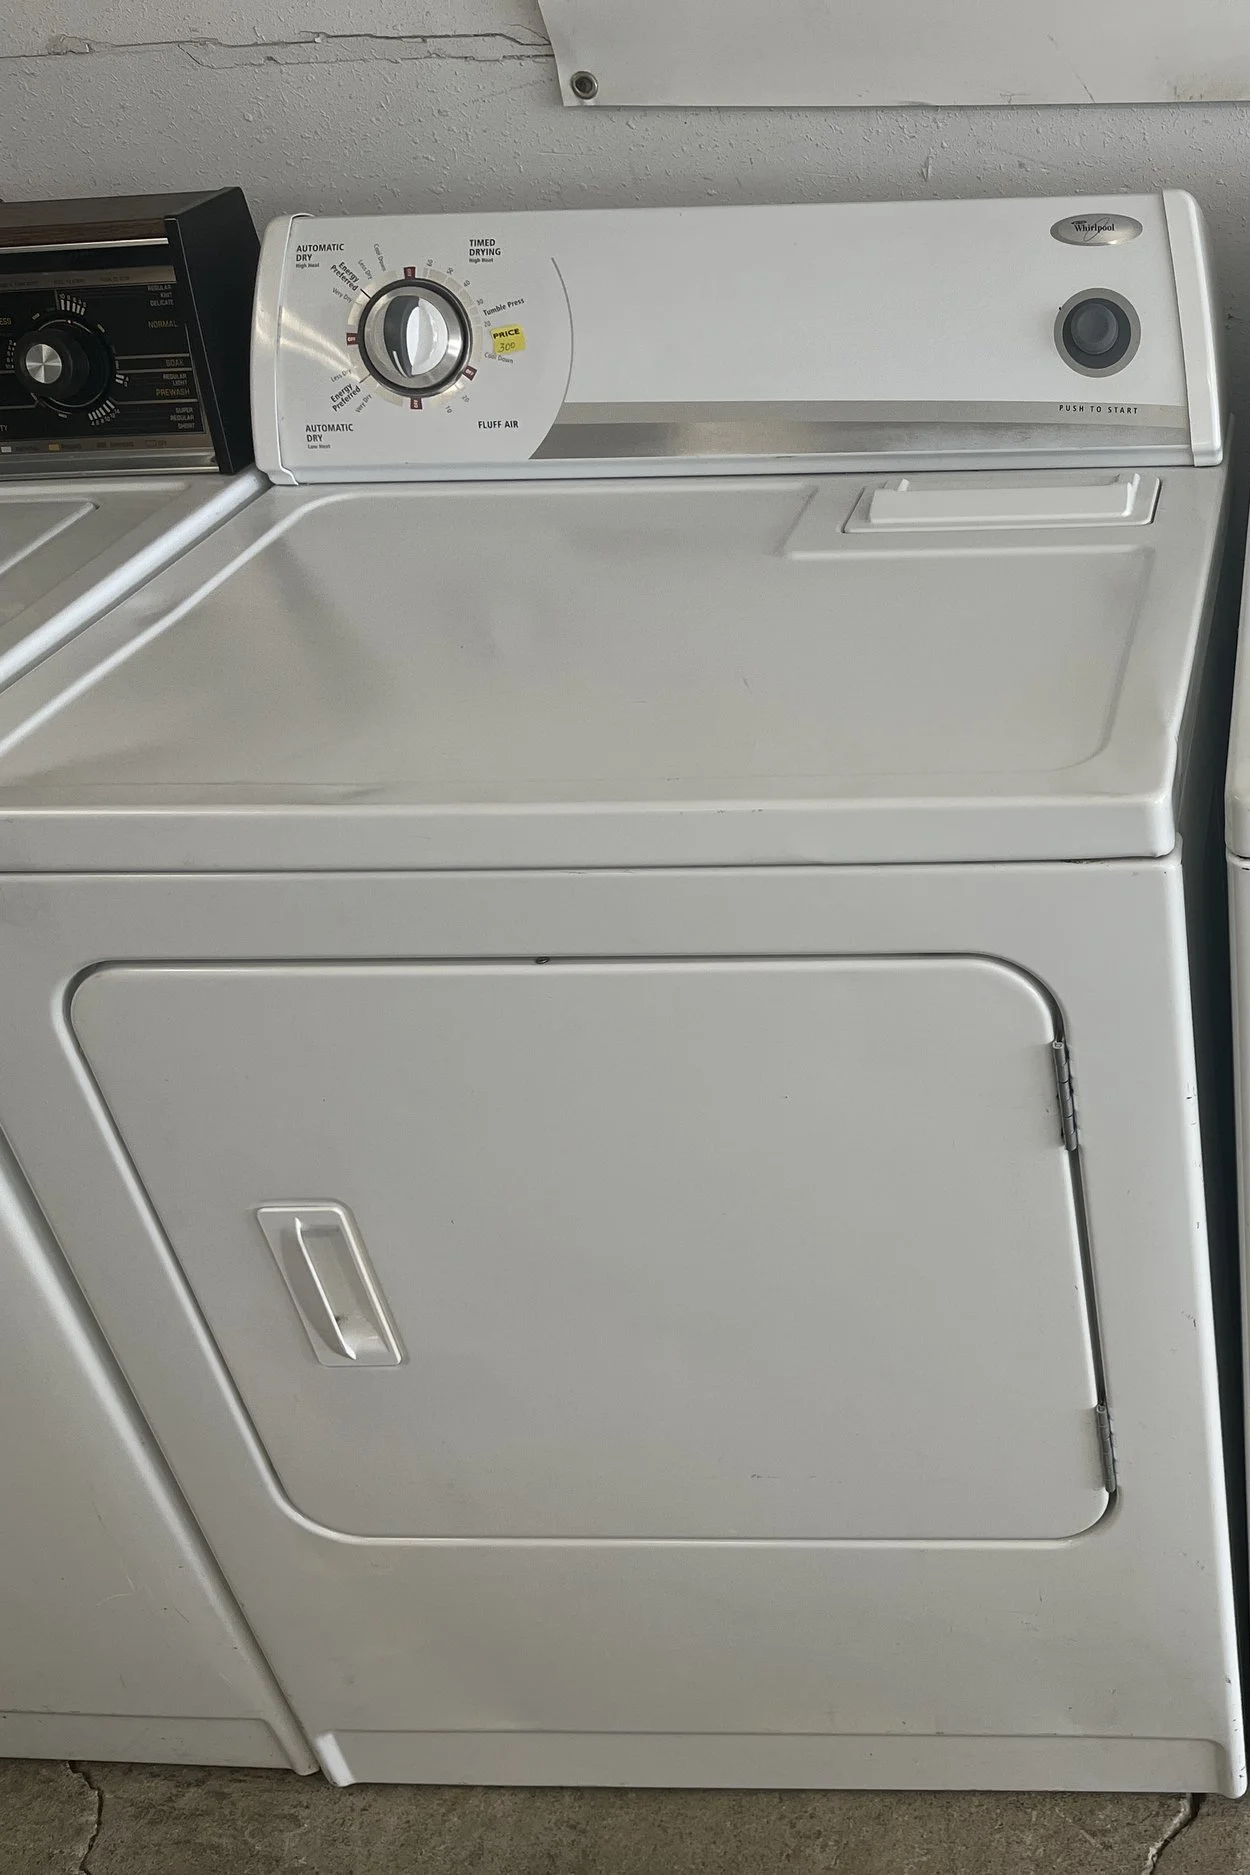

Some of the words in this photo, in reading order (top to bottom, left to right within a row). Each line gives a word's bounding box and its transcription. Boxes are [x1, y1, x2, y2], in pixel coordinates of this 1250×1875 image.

[1074, 223, 1115, 233] Whirlpool
[296, 243, 344, 252] AUTOMATIC
[469, 239, 496, 247] TIMED
[469, 248, 501, 256] DRYING
[296, 254, 313, 262] DRY
[338, 261, 360, 283] Energy
[330, 264, 359, 291] Preferred
[483, 304, 506, 316] Tumble
[507, 298, 525, 308] Press
[493, 328, 520, 339] PRICE
[330, 383, 353, 403] Energy
[332, 385, 361, 412] Preferred
[1059, 404, 1084, 412] PUSH
[1090, 405, 1102, 413] TO
[1108, 406, 1138, 414] START
[305, 423, 354, 433] AUTOMATIC
[478, 420, 502, 429] FLUFF
[504, 420, 519, 428] AIR
[306, 434, 323, 442] DRY
